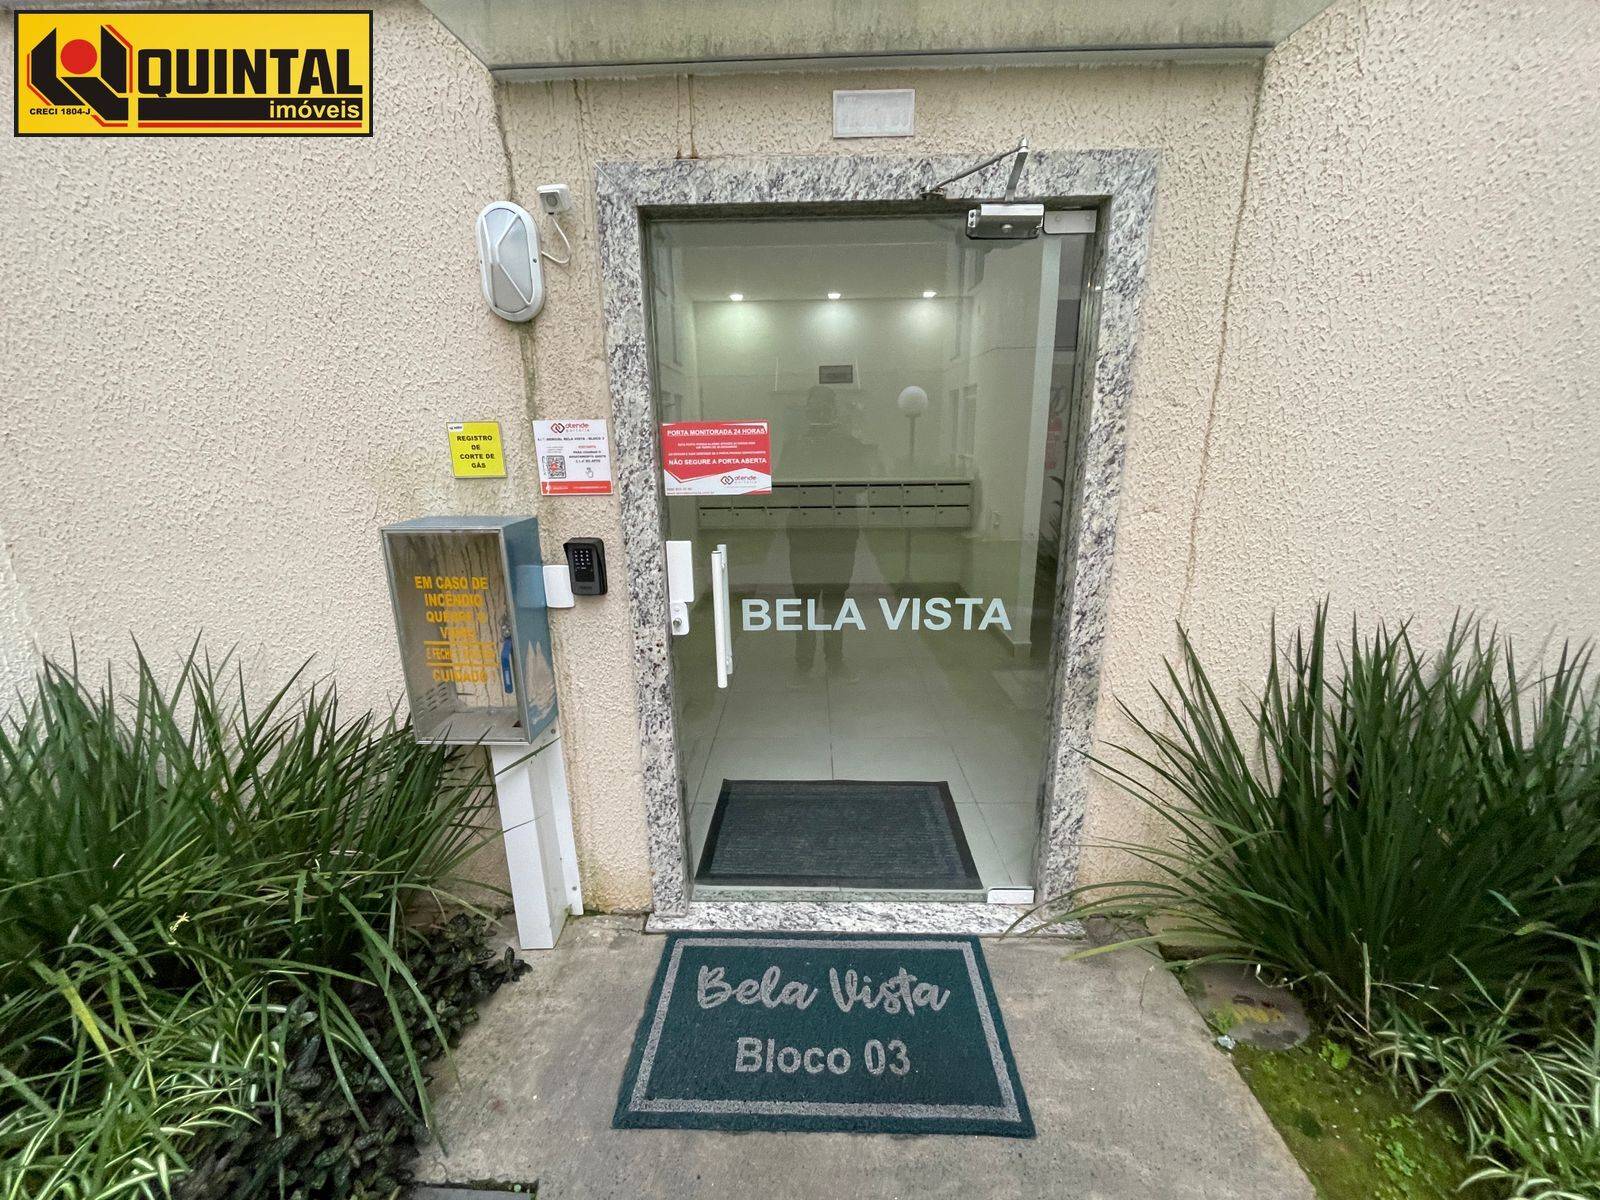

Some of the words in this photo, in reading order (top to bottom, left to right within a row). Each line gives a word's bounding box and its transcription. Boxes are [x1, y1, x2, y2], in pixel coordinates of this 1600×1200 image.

[414, 576, 432, 589] EM
[436, 576, 468, 589] CASO
[472, 576, 488, 590] DE
[425, 591, 483, 607] INCÊNDIO
[741, 598, 866, 631] BELA
[878, 597, 1012, 631] VISTA
[697, 965, 818, 1010] Bela
[829, 967, 950, 1016] Vista
[735, 1036, 851, 1074] Bloco
[864, 1039, 910, 1076] 03
